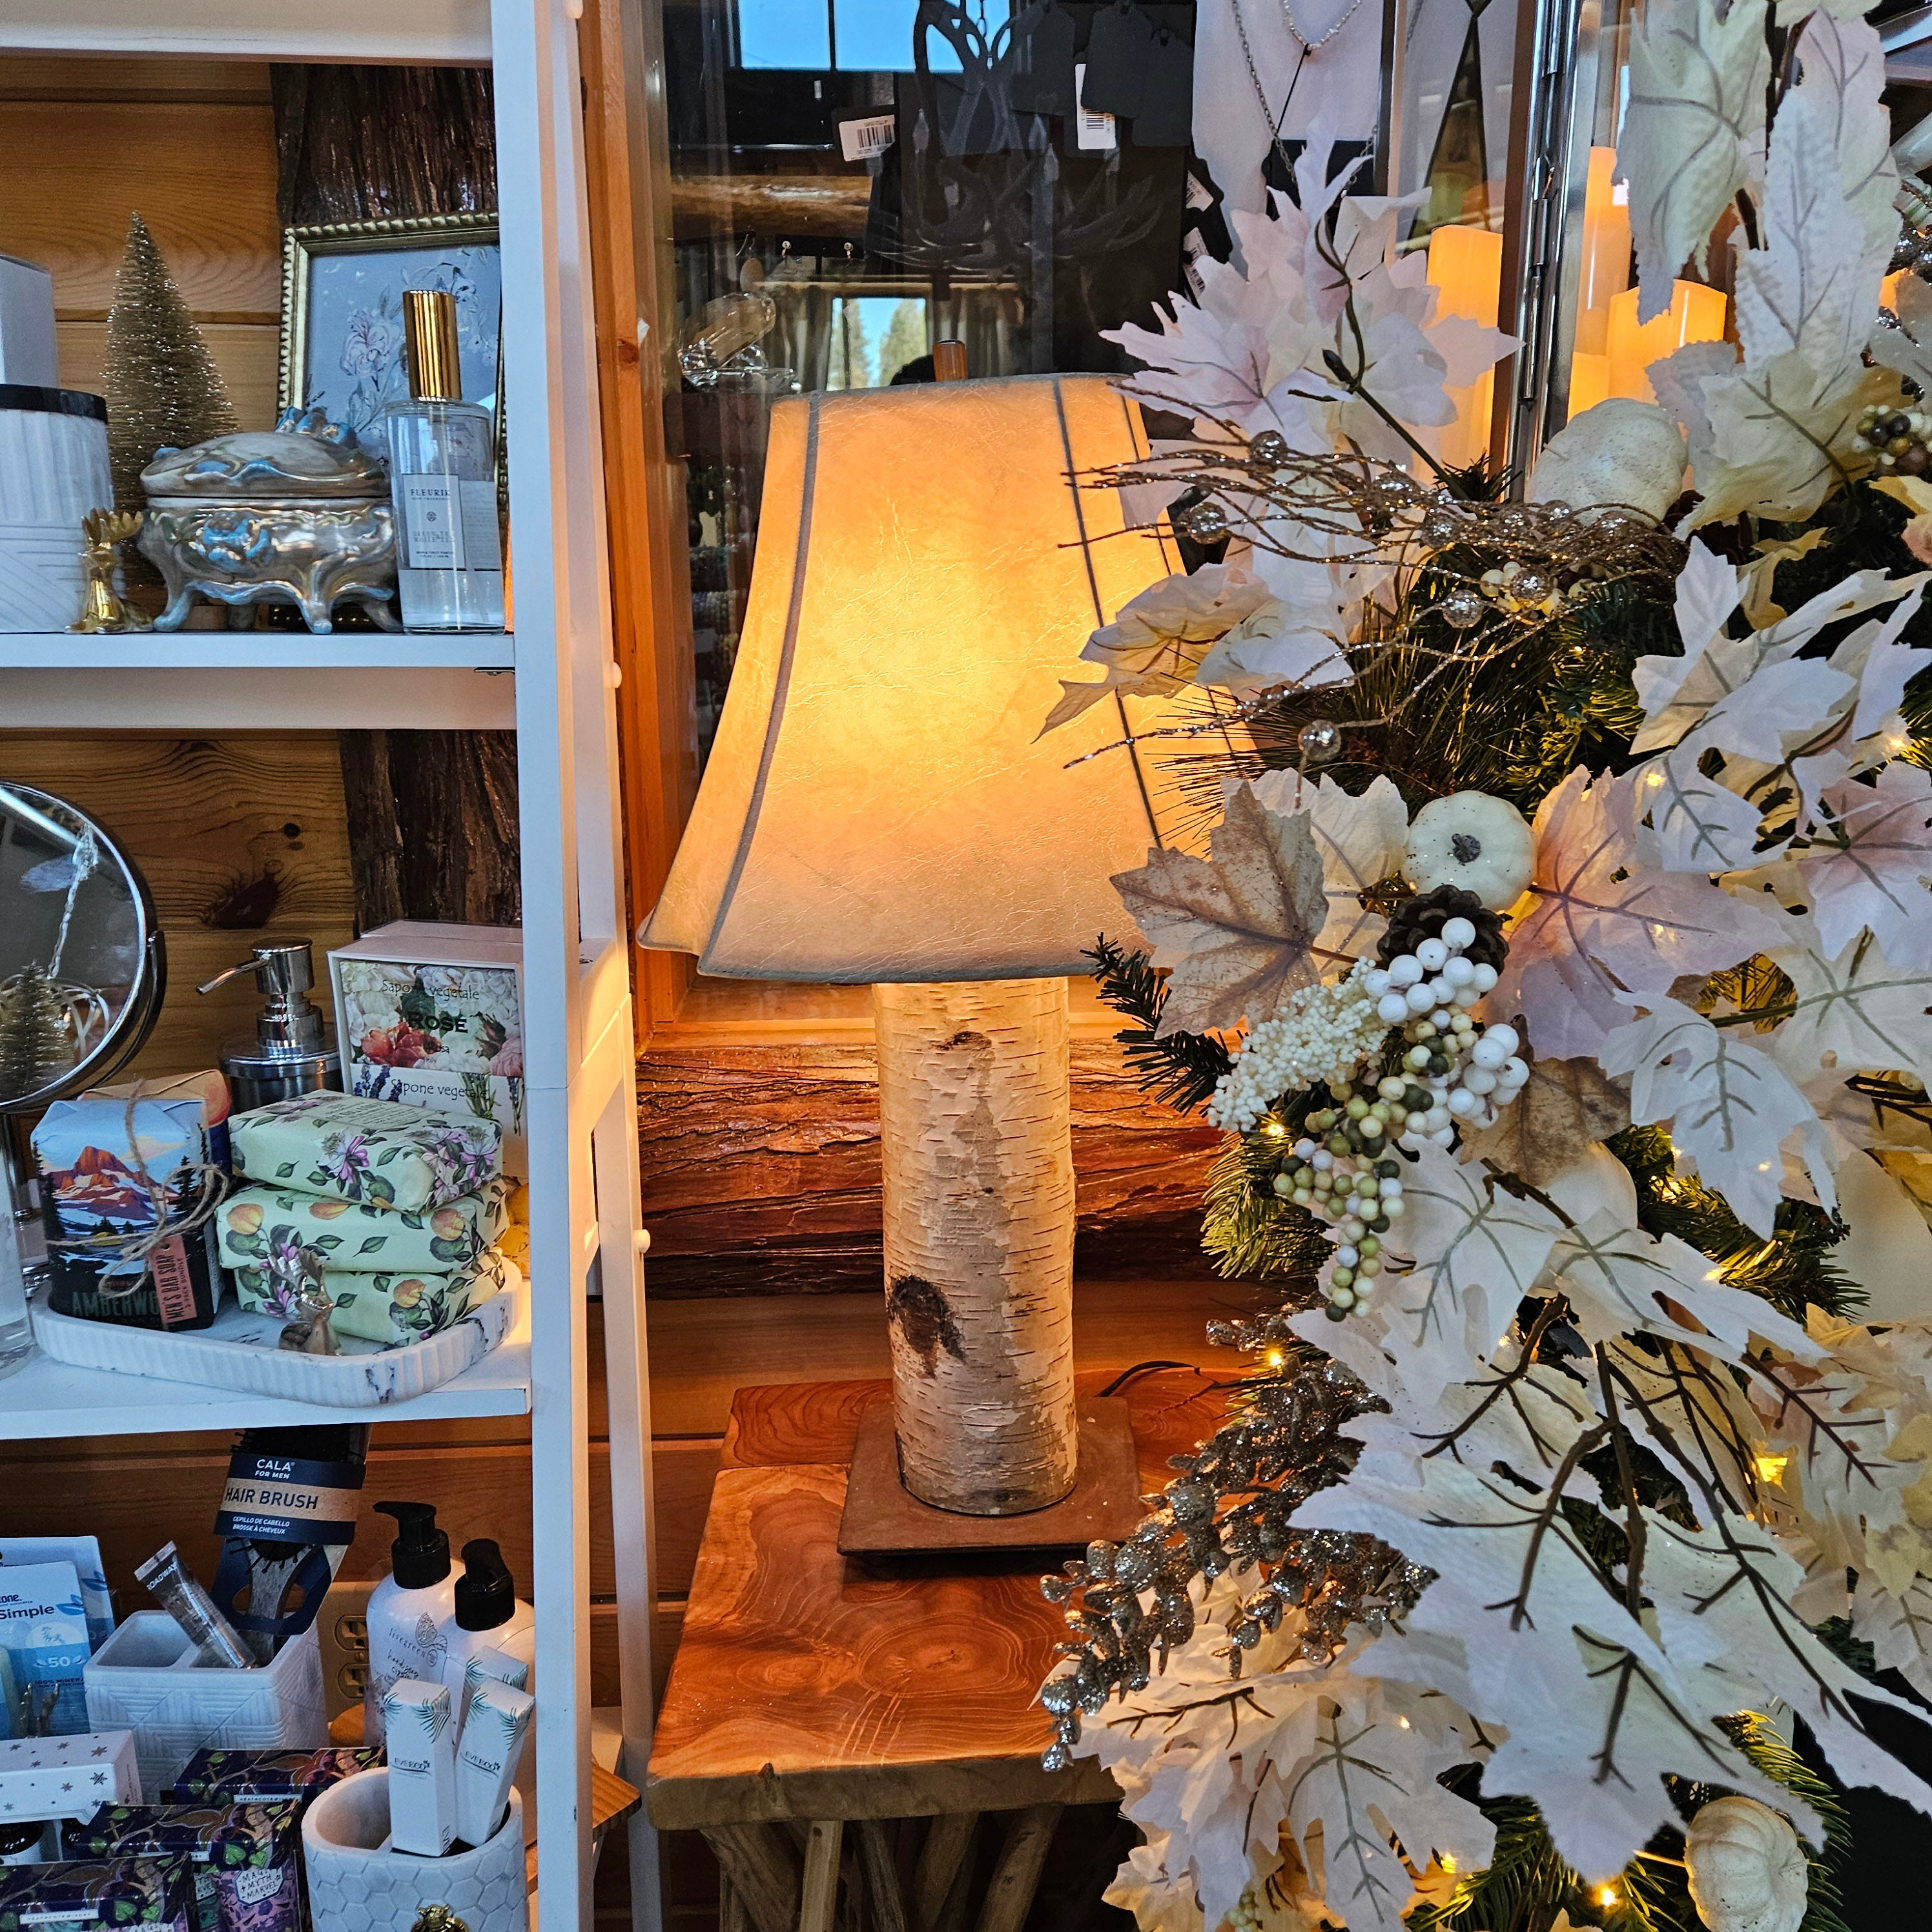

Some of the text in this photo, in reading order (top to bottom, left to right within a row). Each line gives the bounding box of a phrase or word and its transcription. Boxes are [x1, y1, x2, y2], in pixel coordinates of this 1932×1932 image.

[382, 979, 479, 1002] Sapo vegetale
[407, 1011, 468, 1033] ROSE
[391, 1079, 434, 1096] Spone
[156, 1255, 185, 1319] MEN'S BAR SOAP
[72, 1290, 161, 1317] AMBERWO
[225, 1487, 318, 1510] HAIR BRUSH
[47, 1656, 70, 1667] 50
